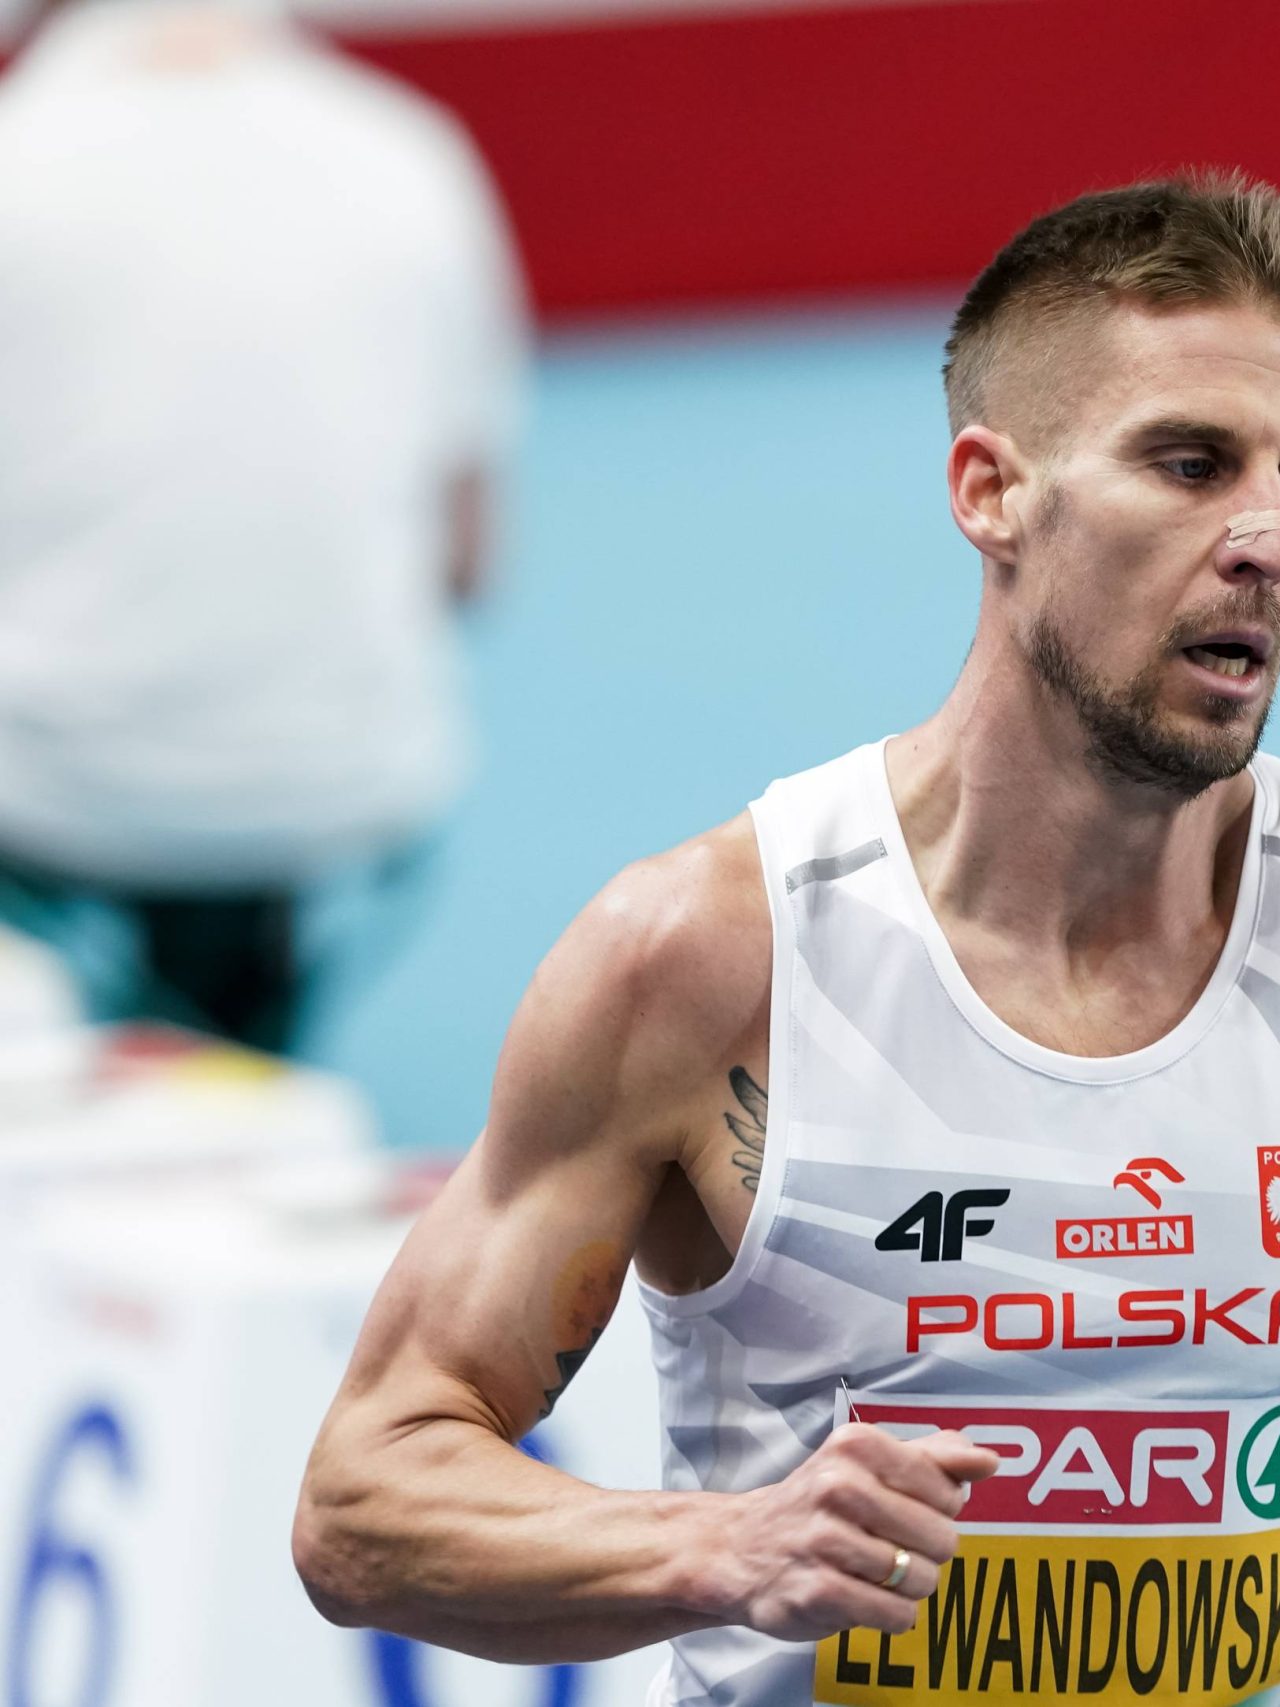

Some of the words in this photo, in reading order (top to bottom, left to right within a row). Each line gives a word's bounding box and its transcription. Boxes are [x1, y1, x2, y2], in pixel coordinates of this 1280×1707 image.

[874, 1188, 1011, 1262] 4F
[1063, 1220, 1186, 1253] ORLEN
[873, 1421, 1216, 1507] PAR
